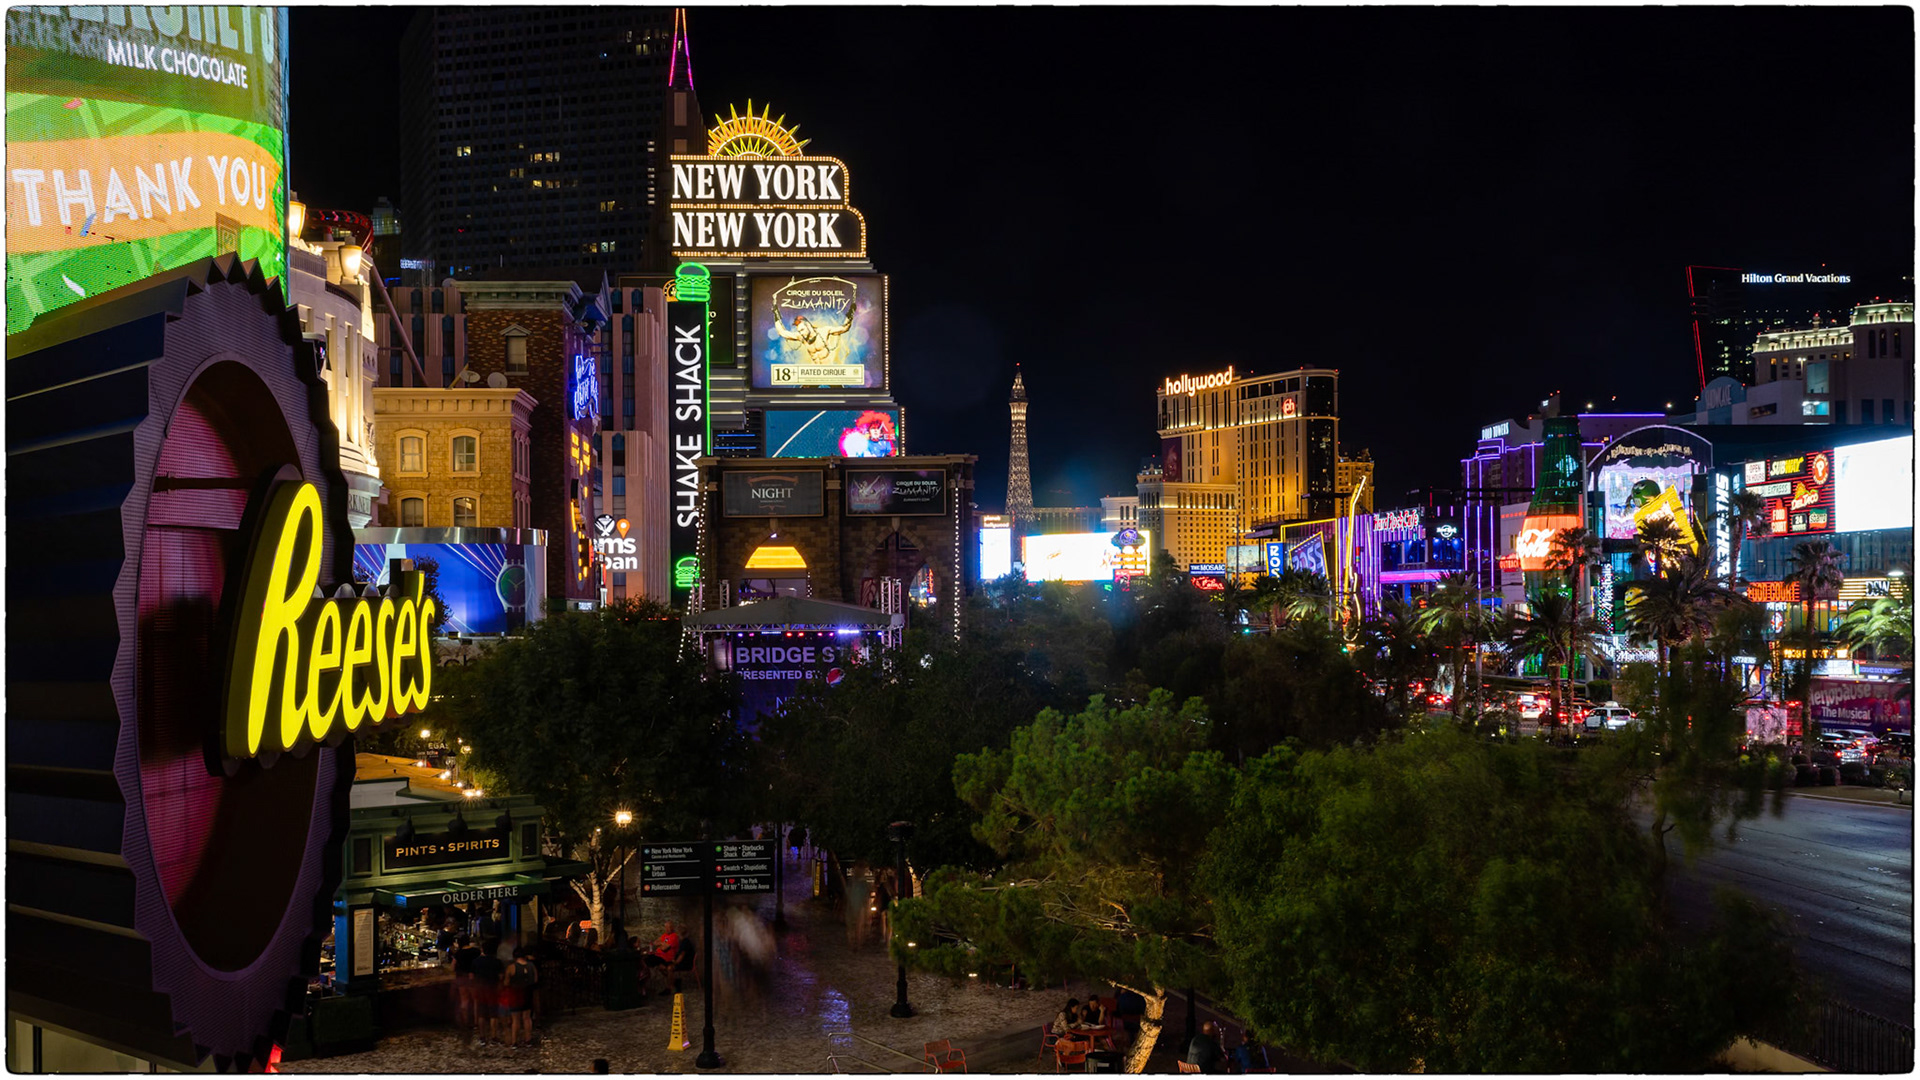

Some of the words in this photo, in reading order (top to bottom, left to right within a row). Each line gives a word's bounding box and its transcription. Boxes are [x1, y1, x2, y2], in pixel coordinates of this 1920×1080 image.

[107, 39, 158, 71] MILK
[161, 48, 249, 89] CHOCOLATE
[12, 156, 201, 227] THANK
[207, 155, 266, 210] YOU
[672, 164, 746, 199] NEW
[753, 164, 842, 200] YORK
[672, 212, 746, 247] NEW
[753, 212, 842, 248] YORK
[1741, 273, 1773, 284] Hilton
[1774, 273, 1804, 284] Grand
[1805, 273, 1851, 284] Vacations
[781, 296, 850, 314] ZUMANITY
[674, 324, 702, 422] SHACK
[800, 368, 822, 376] RATED
[822, 368, 846, 376] CIRQUE
[1165, 365, 1233, 397] hollywood
[1769, 457, 1804, 476] SUBWAY
[676, 434, 702, 528] SHAKE
[1767, 484, 1788, 494] EXPRESS
[751, 487, 794, 499] NIGHT
[892, 486, 941, 498] ZUMANITY
[1373, 513, 1390, 531] Hard
[1389, 511, 1404, 532] Rock
[1403, 509, 1420, 530] Cafe
[1772, 508, 1785, 520] FOOD
[1794, 515, 1803, 524] 24
[1269, 545, 1281, 578] ROS
[1602, 563, 1613, 612] Marshalls
[1865, 581, 1890, 597] DSW
[247, 483, 435, 755] Reese's
[736, 646, 816, 663] BRIDGE
[1822, 706, 1837, 718] The
[1838, 708, 1871, 720] Musical
[395, 845, 437, 858] PINTS
[448, 839, 500, 852] SPIRITS
[442, 888, 485, 904] ORDER
[488, 886, 518, 899] HERE
